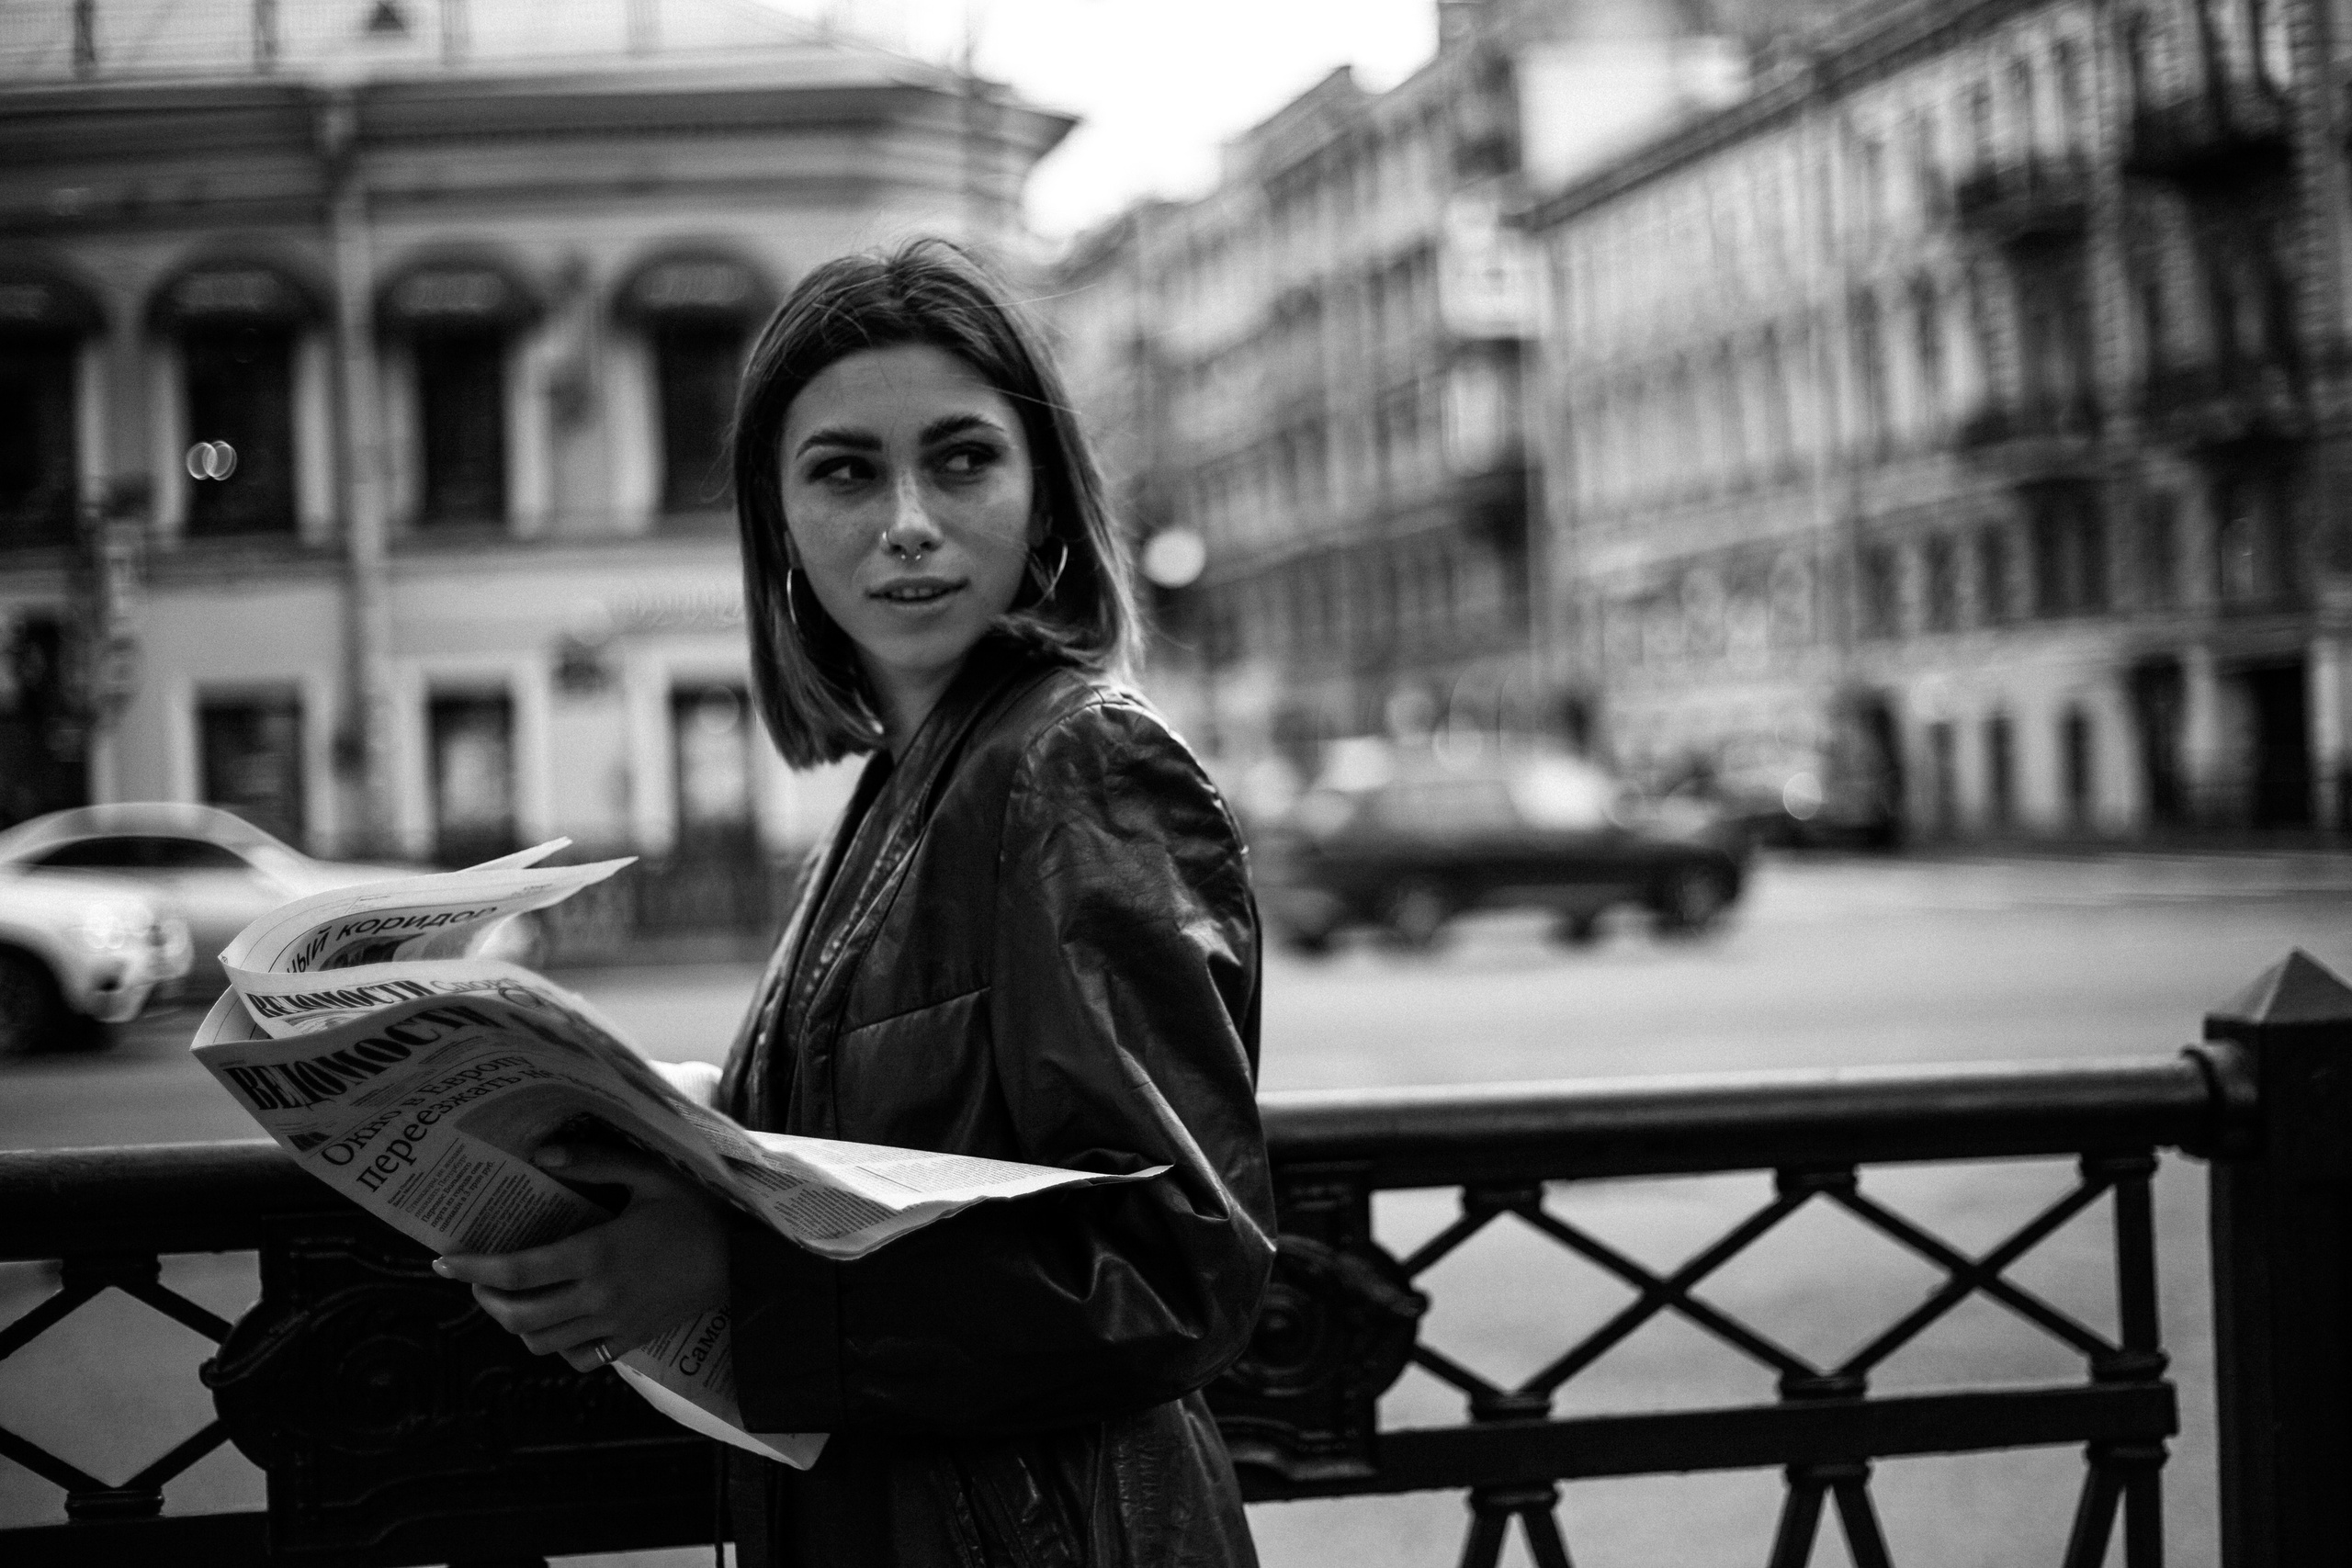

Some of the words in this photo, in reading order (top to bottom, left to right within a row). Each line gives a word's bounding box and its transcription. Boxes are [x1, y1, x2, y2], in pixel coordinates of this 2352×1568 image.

[244, 980, 437, 1019] ВЕДОМОСТИ
[222, 1006, 508, 1111] ВЕДОМОСТИ
[322, 1111, 401, 1166] Окно
[416, 1056, 535, 1095] Европу
[356, 1077, 521, 1192] переезжать
